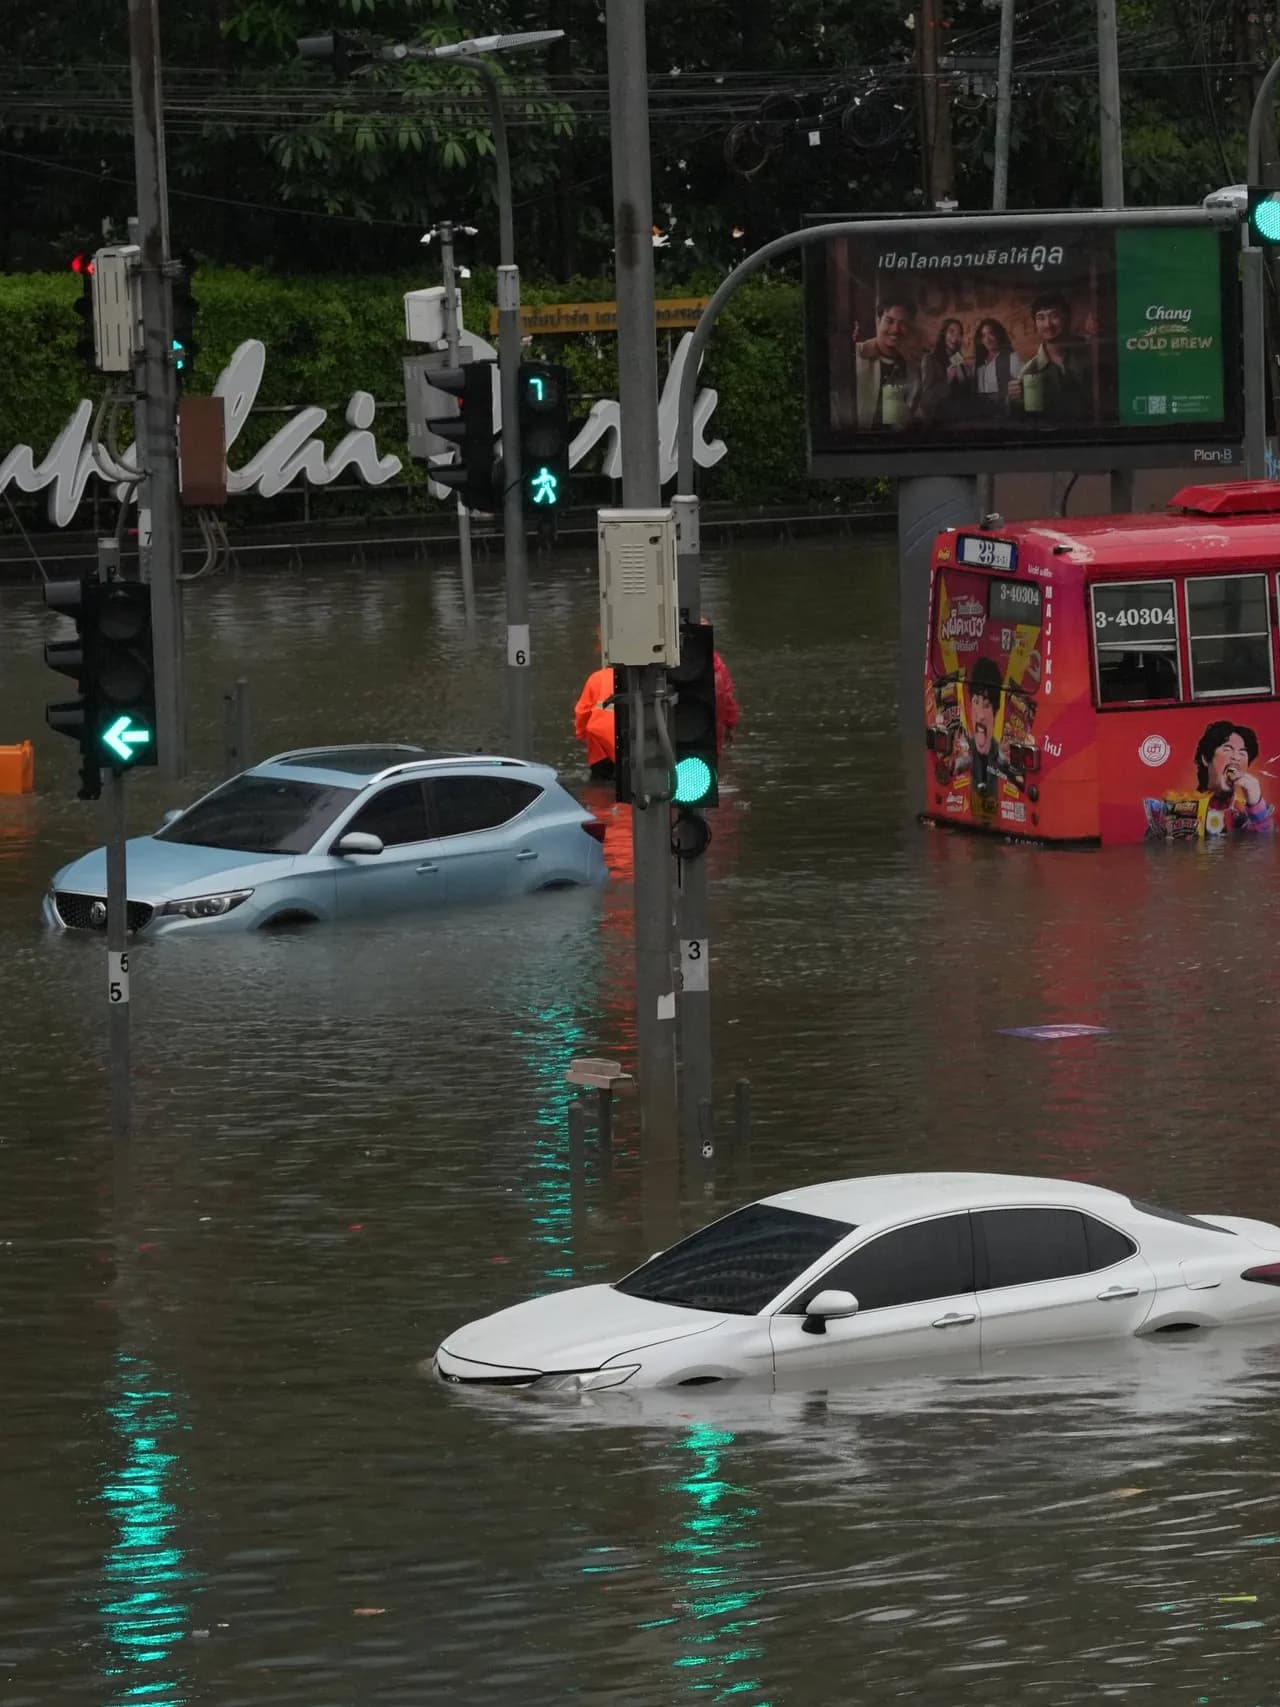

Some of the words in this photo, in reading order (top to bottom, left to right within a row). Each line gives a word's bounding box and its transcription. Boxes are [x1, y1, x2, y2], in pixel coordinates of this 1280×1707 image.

[1145, 305, 1192, 322] Chang
[1126, 337, 1168, 350] COLD
[1171, 336, 1213, 349] BREW
[529, 379, 543, 400] 7
[1000, 583, 1040, 606] 3-40304
[1095, 607, 1175, 628] 3-40304
[1045, 585, 1053, 694] MAJIKO
[515, 649, 526, 665] 6
[688, 941, 701, 960] 3
[110, 982, 122, 1002] 5
